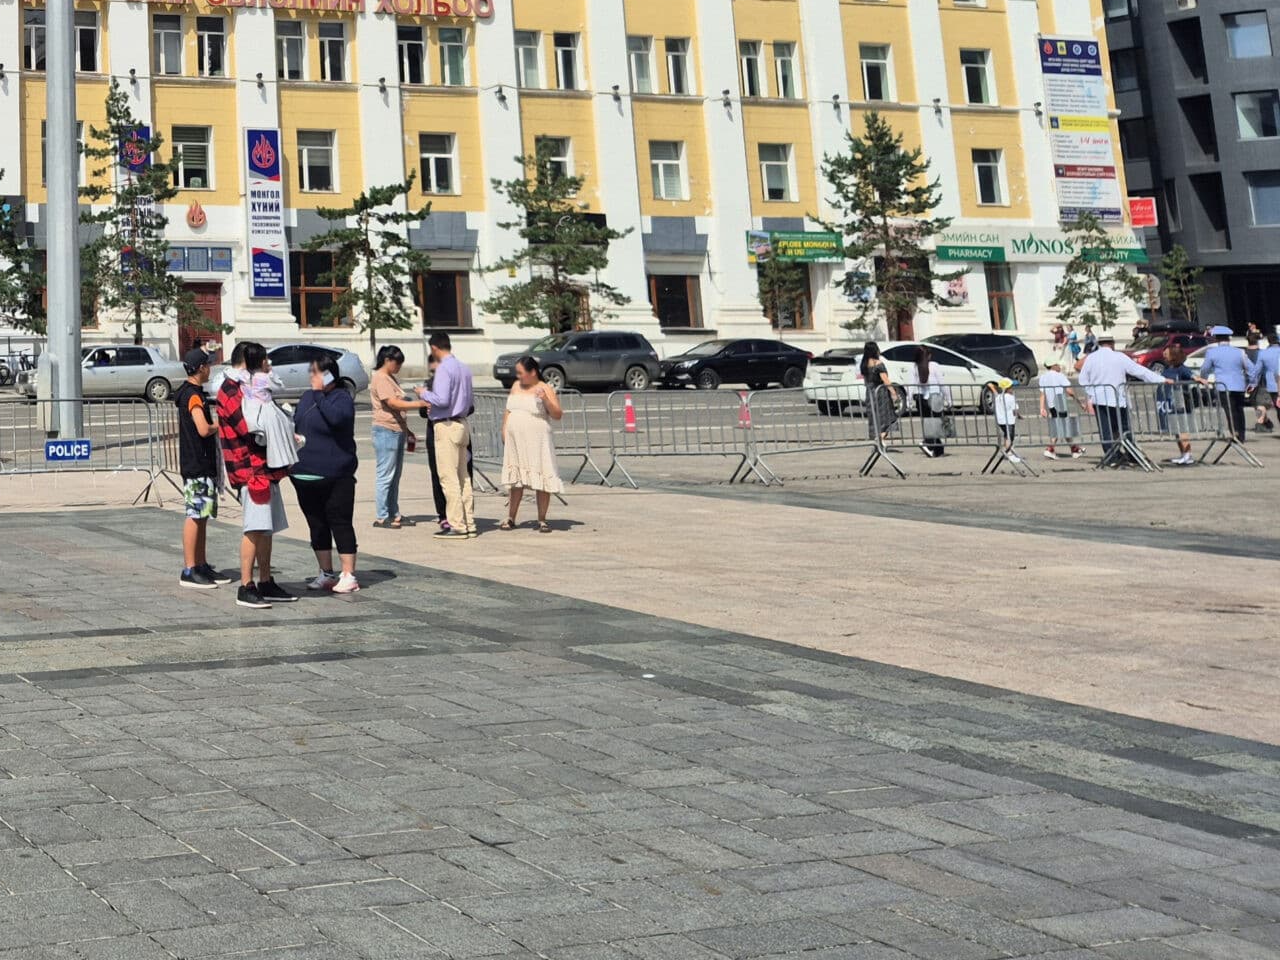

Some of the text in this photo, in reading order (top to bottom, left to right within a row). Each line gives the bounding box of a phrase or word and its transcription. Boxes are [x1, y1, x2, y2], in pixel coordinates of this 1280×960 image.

[251, 190, 280, 199] МОНГОЛ
[979, 233, 1000, 243] САН
[1012, 235, 1075, 255] MONOS
[948, 249, 993, 258] PHARMACY
[49, 444, 89, 457] POLICE
